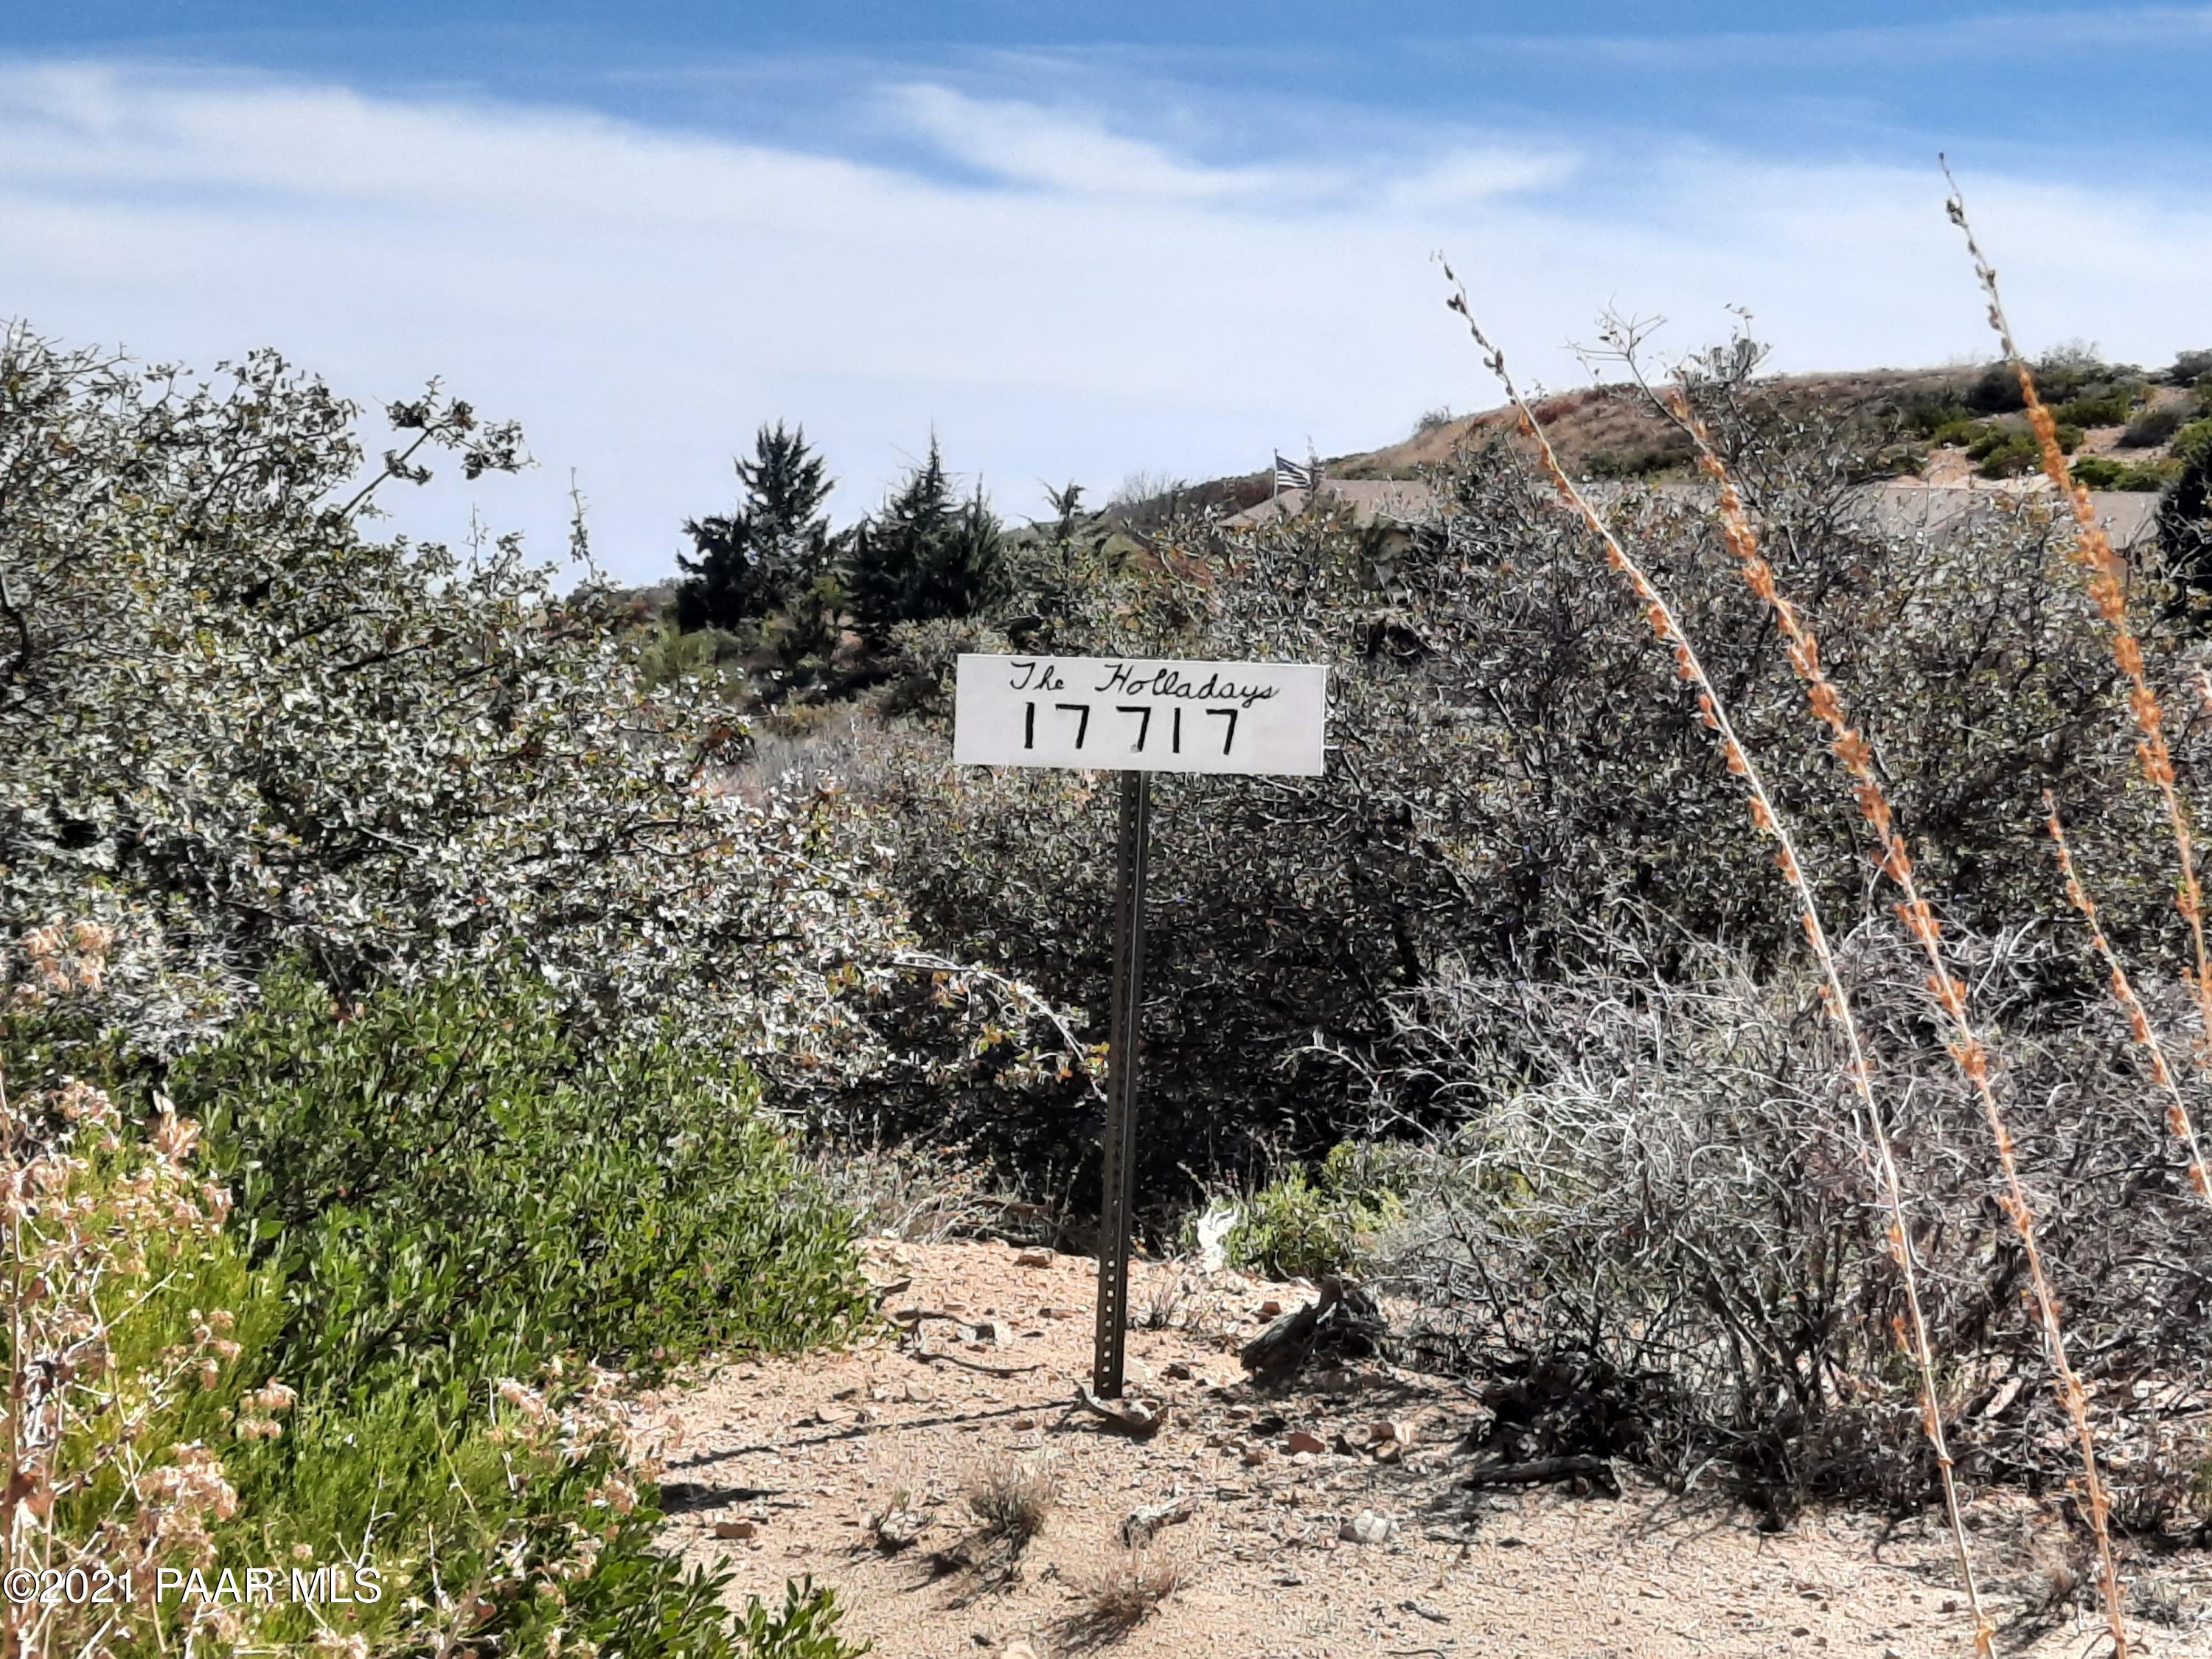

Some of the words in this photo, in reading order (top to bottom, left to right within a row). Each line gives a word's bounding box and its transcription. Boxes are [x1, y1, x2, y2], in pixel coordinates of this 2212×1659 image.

[1009, 661, 1065, 691] The
[1095, 663, 1280, 708] Holladays
[1023, 701, 1238, 756] 17717
